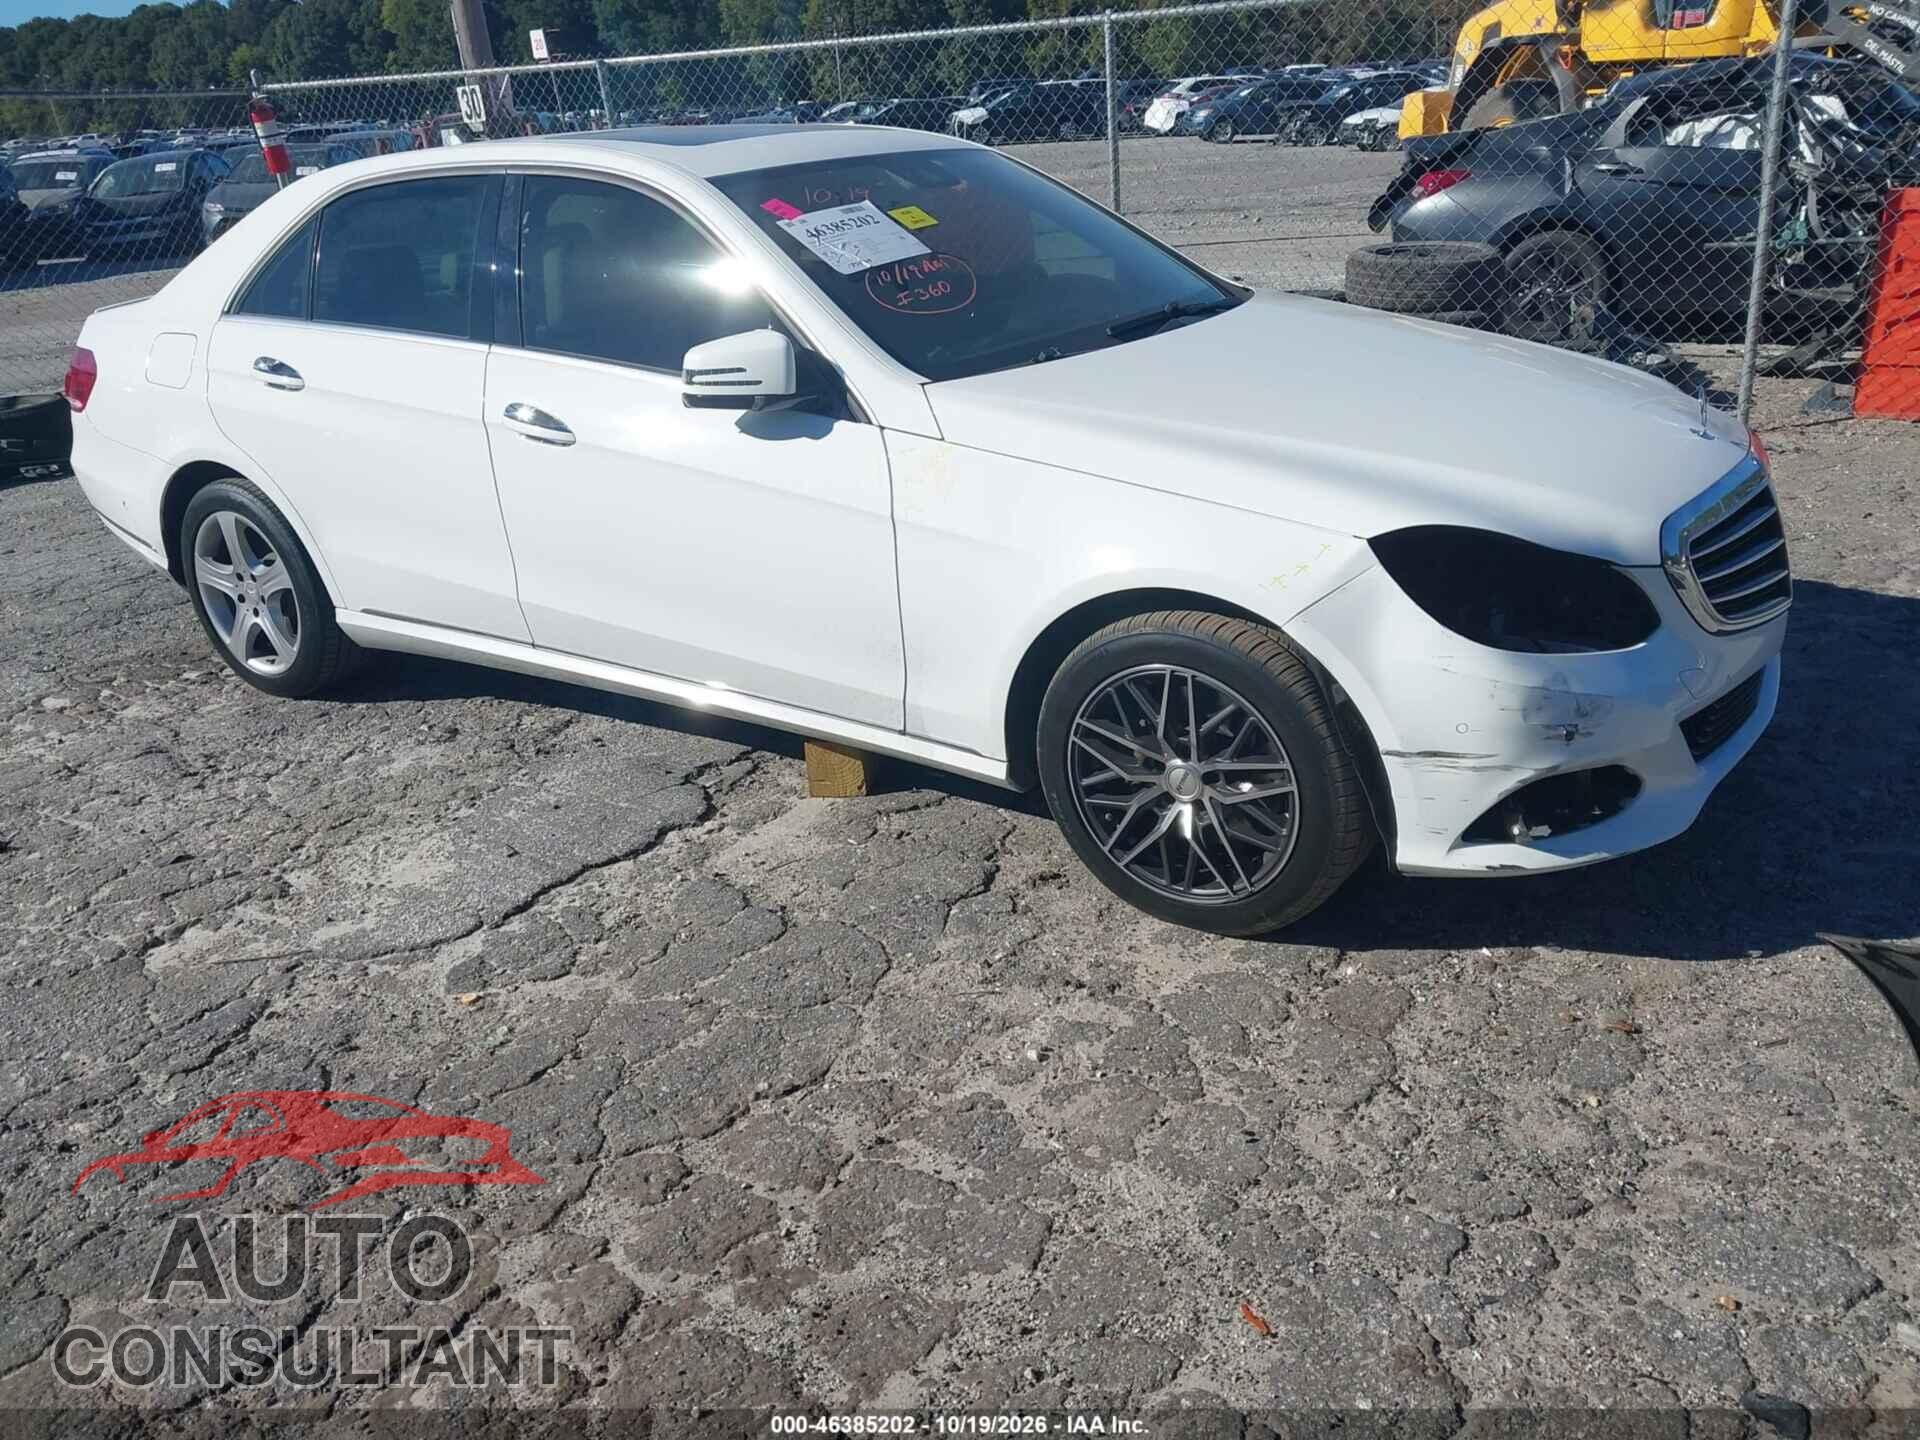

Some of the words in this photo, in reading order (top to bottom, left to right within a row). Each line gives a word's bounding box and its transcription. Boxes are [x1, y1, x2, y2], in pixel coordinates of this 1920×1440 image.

[1870, 4, 1885, 16] NO
[1884, 10, 1918, 30] CAMINE
[1864, 39, 1880, 55] DEL
[460, 87, 483, 121] 30
[804, 213, 881, 241] 46385202
